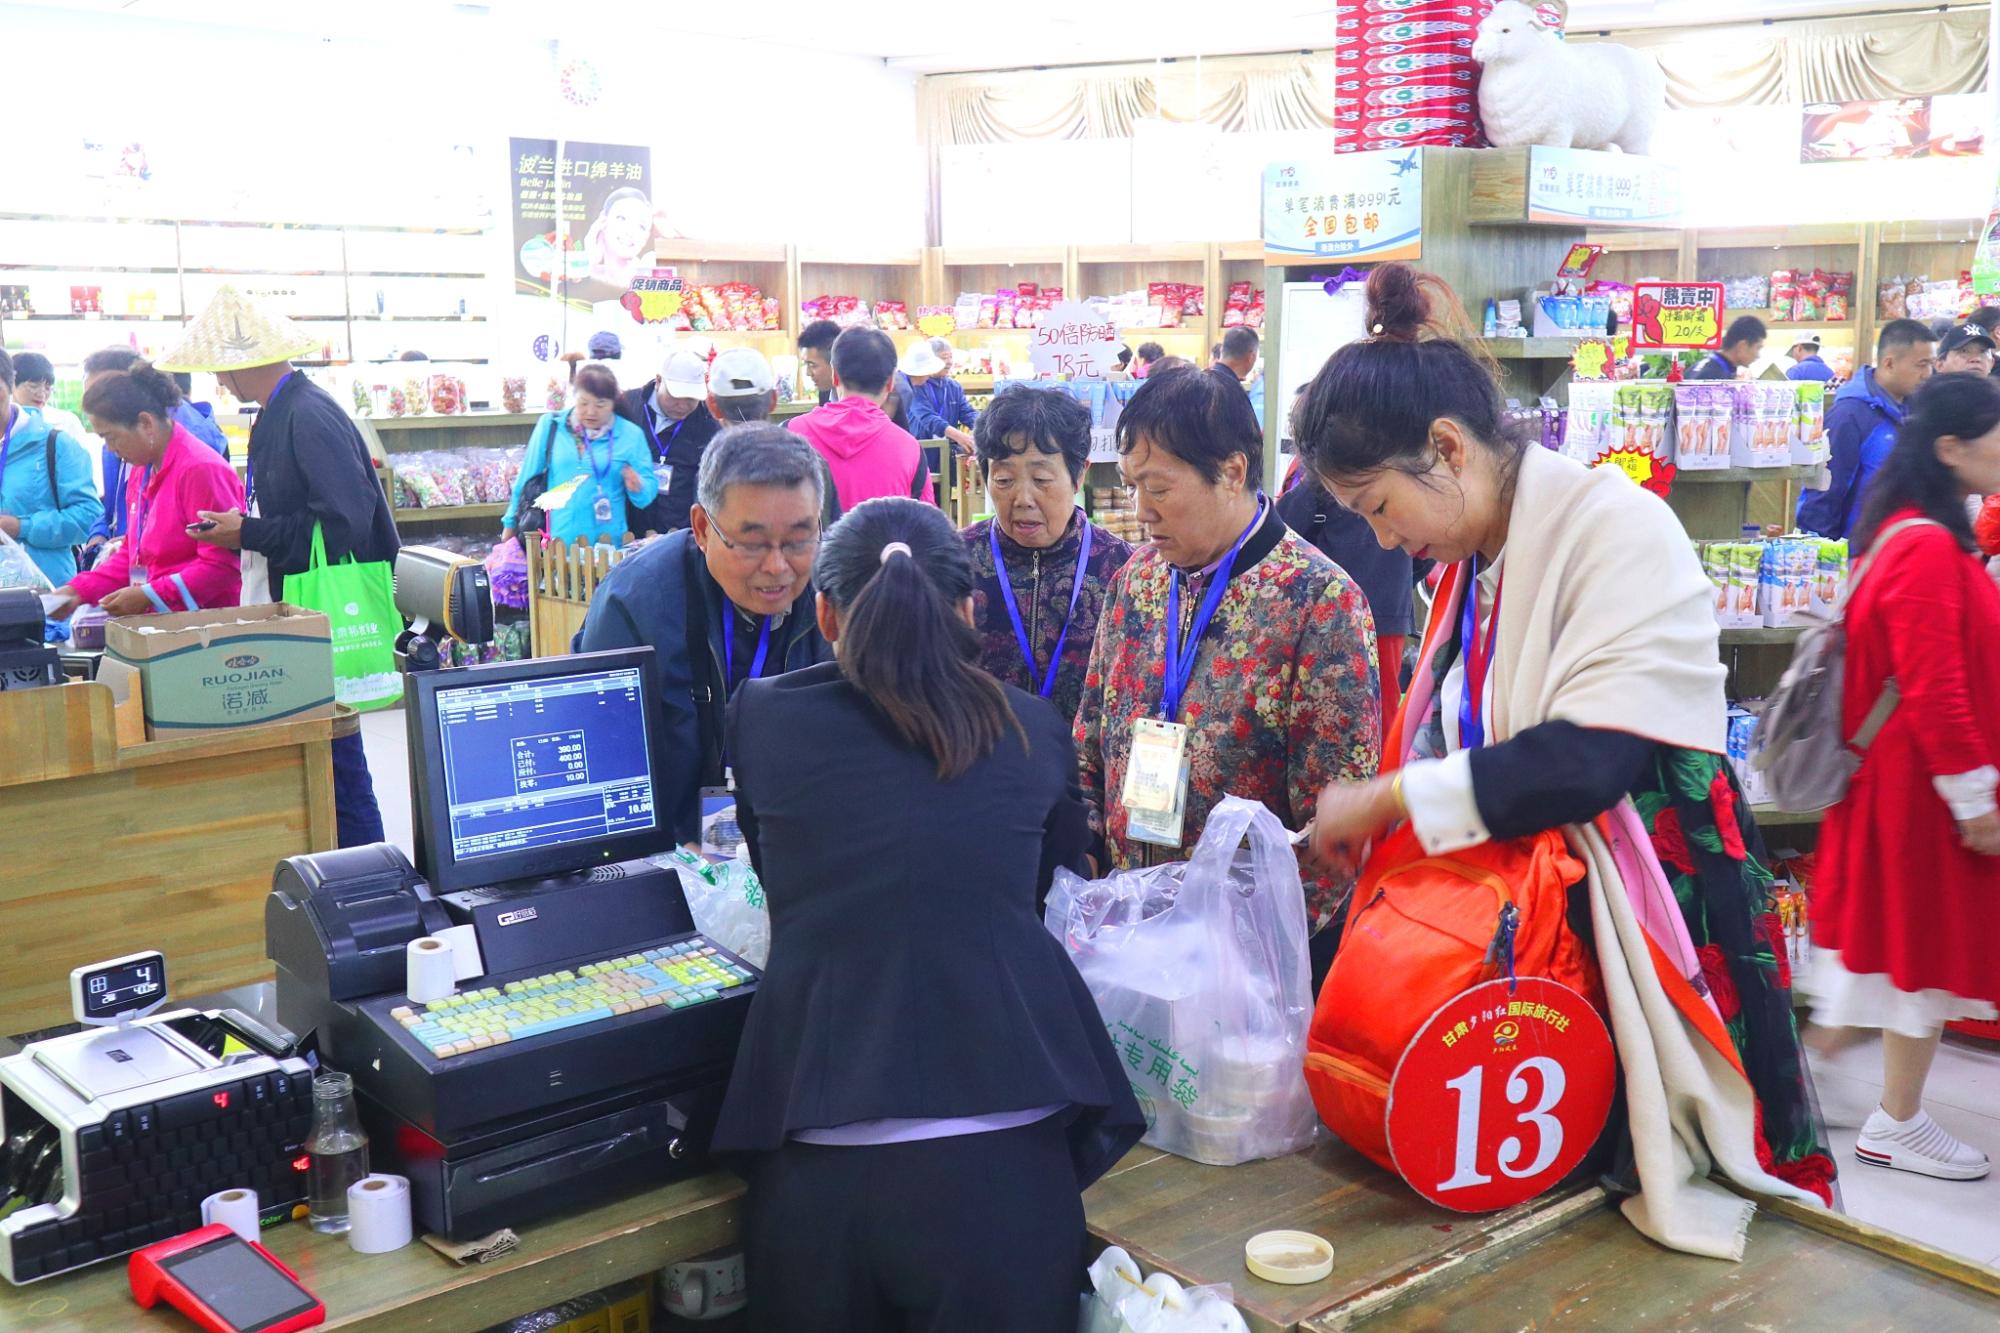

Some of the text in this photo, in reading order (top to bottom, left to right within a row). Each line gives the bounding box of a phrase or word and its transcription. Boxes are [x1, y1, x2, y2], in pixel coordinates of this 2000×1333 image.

[519, 154, 642, 180] 波兰进口绵羊油
[1304, 212, 1380, 238] 全国包邮
[632, 278, 683, 291] 促销商品
[1663, 287, 1714, 306] 熱賣中
[1038, 321, 1116, 346] 50倍防晒
[1052, 353, 1100, 378] 78元
[202, 667, 284, 687] RUOJIAN
[567, 761, 583, 770] 0.00
[566, 772, 585, 782] 10.00
[628, 802, 652, 815] 10.00
[136, 966, 151, 982] 4
[213, 1091, 230, 1108] 4
[1436, 1056, 1567, 1192] 13
